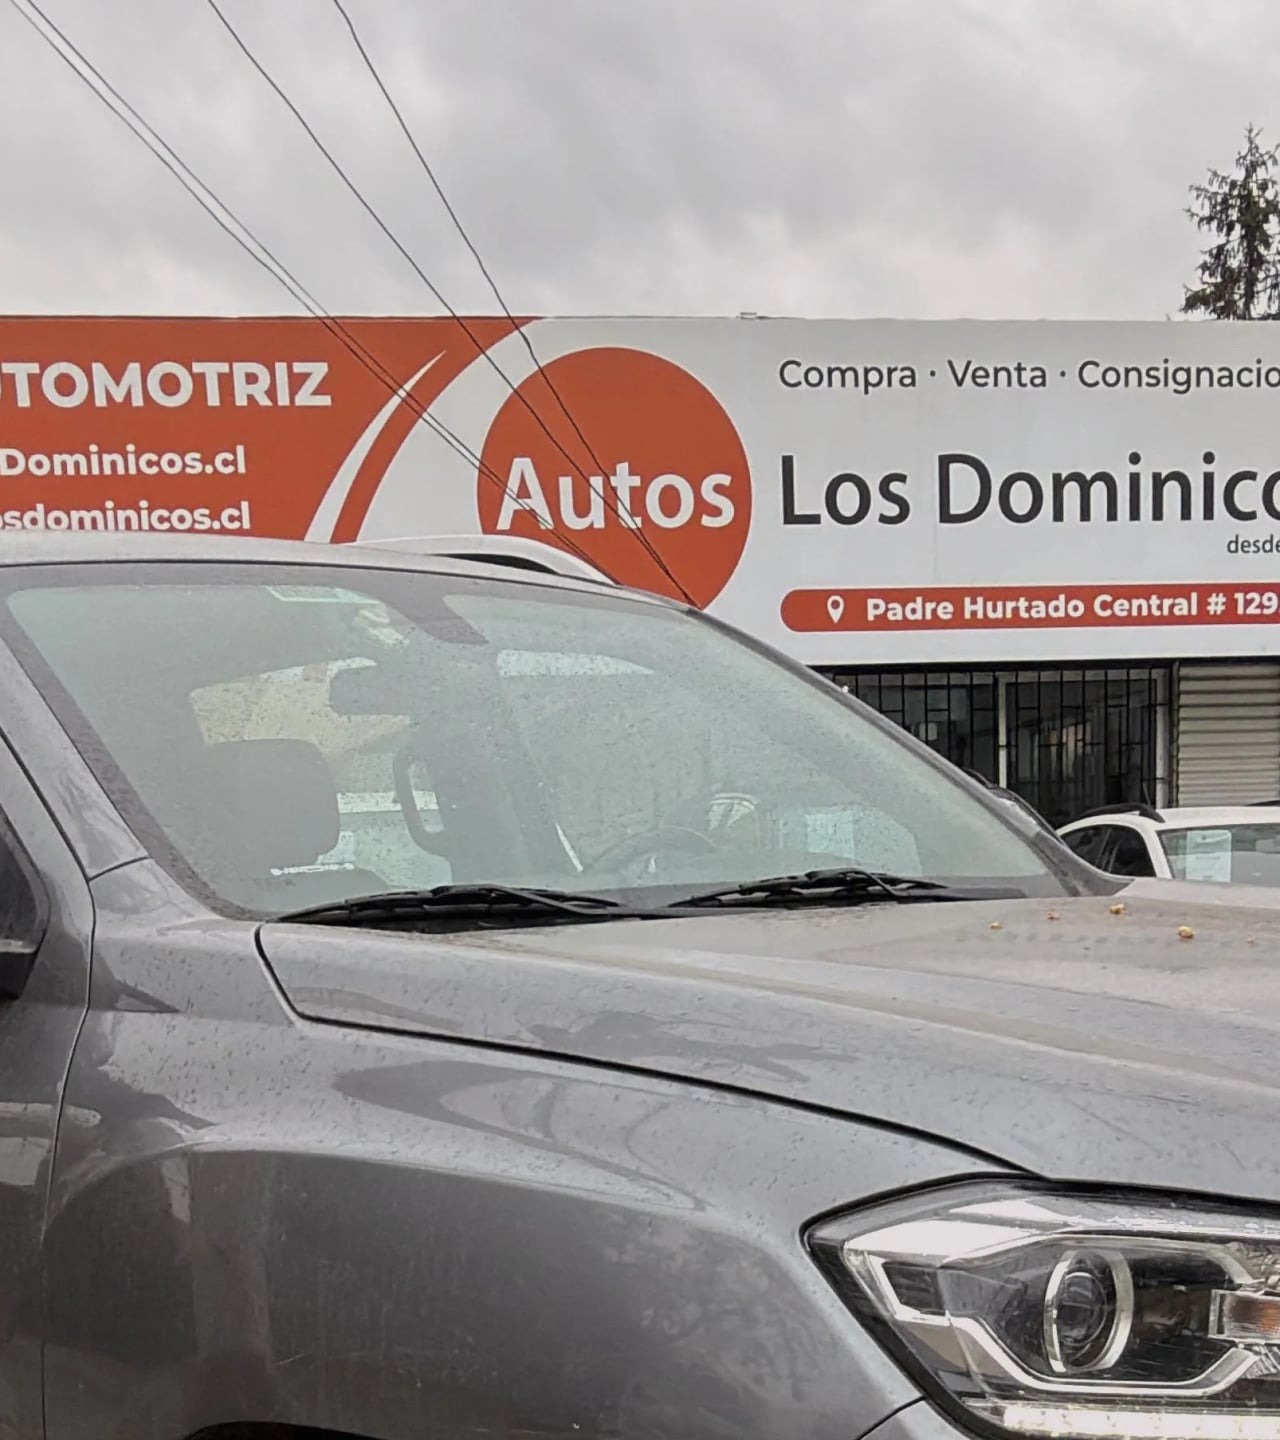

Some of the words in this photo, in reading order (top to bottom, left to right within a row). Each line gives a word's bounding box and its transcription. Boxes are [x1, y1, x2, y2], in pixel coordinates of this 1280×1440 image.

[778, 359, 917, 396] Compra
[946, 359, 1047, 388] Venta
[495, 456, 737, 532] Autos
[780, 454, 911, 527] Los
[866, 595, 954, 622] Padre
[964, 592, 1085, 620] Hurtado
[1093, 590, 1199, 618] Central
